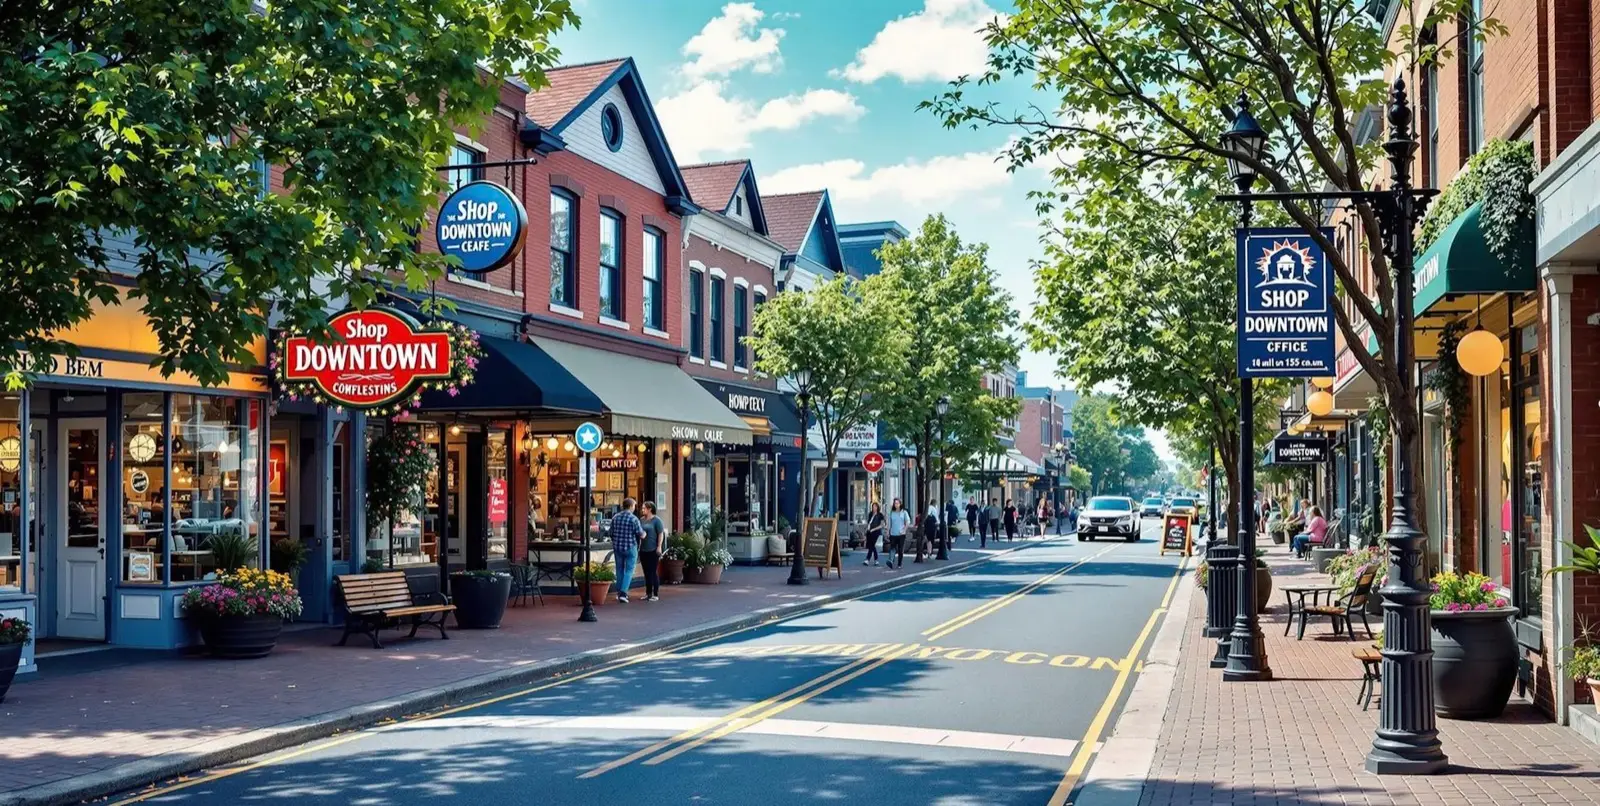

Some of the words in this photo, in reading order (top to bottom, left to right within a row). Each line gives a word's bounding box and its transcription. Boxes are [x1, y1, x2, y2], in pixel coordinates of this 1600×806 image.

[457, 200, 498, 221] SHOP
[441, 221, 512, 240] DOWNTOWN
[461, 240, 490, 252] CEAFE
[1261, 290, 1309, 308] SHOP
[345, 319, 388, 342] Shop
[1245, 316, 1328, 333] DOWNTOWN
[295, 343, 439, 371] DOWNTOWN
[65, 357, 103, 377] BEM
